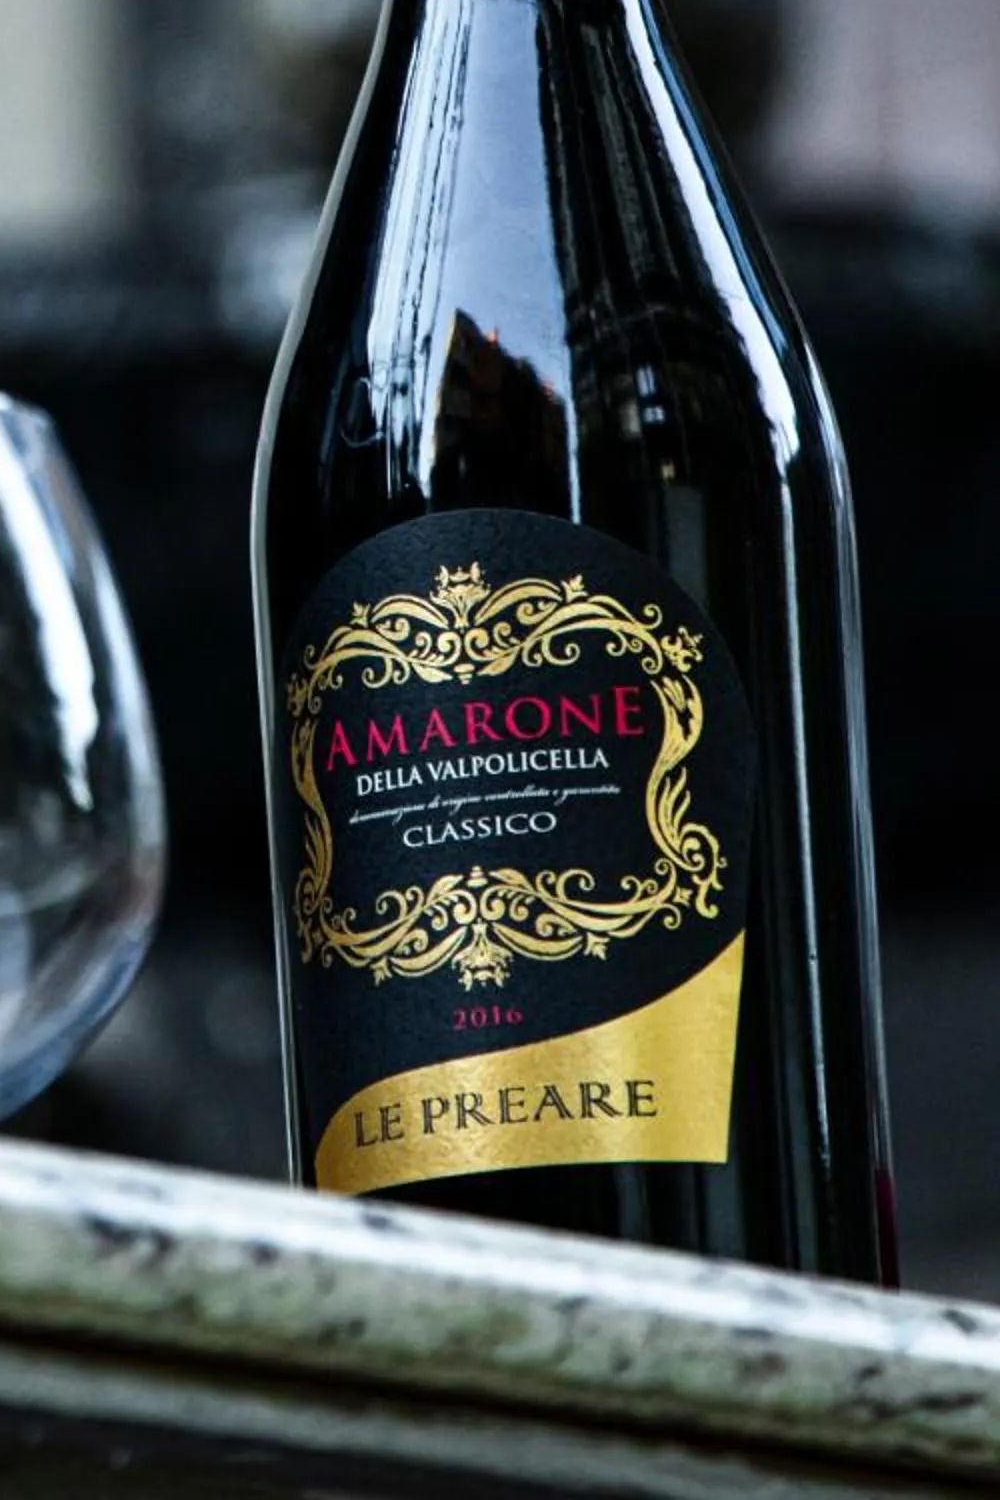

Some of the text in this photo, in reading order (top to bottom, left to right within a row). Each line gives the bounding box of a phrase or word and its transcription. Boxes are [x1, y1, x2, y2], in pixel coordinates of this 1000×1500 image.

[325, 684, 645, 772] AMARONE
[356, 747, 609, 796] DELLA VALPOLICELLA
[402, 811, 557, 848] CLASSICO
[453, 1004, 524, 1031] 2016
[354, 1080, 659, 1148] LE PREARE
